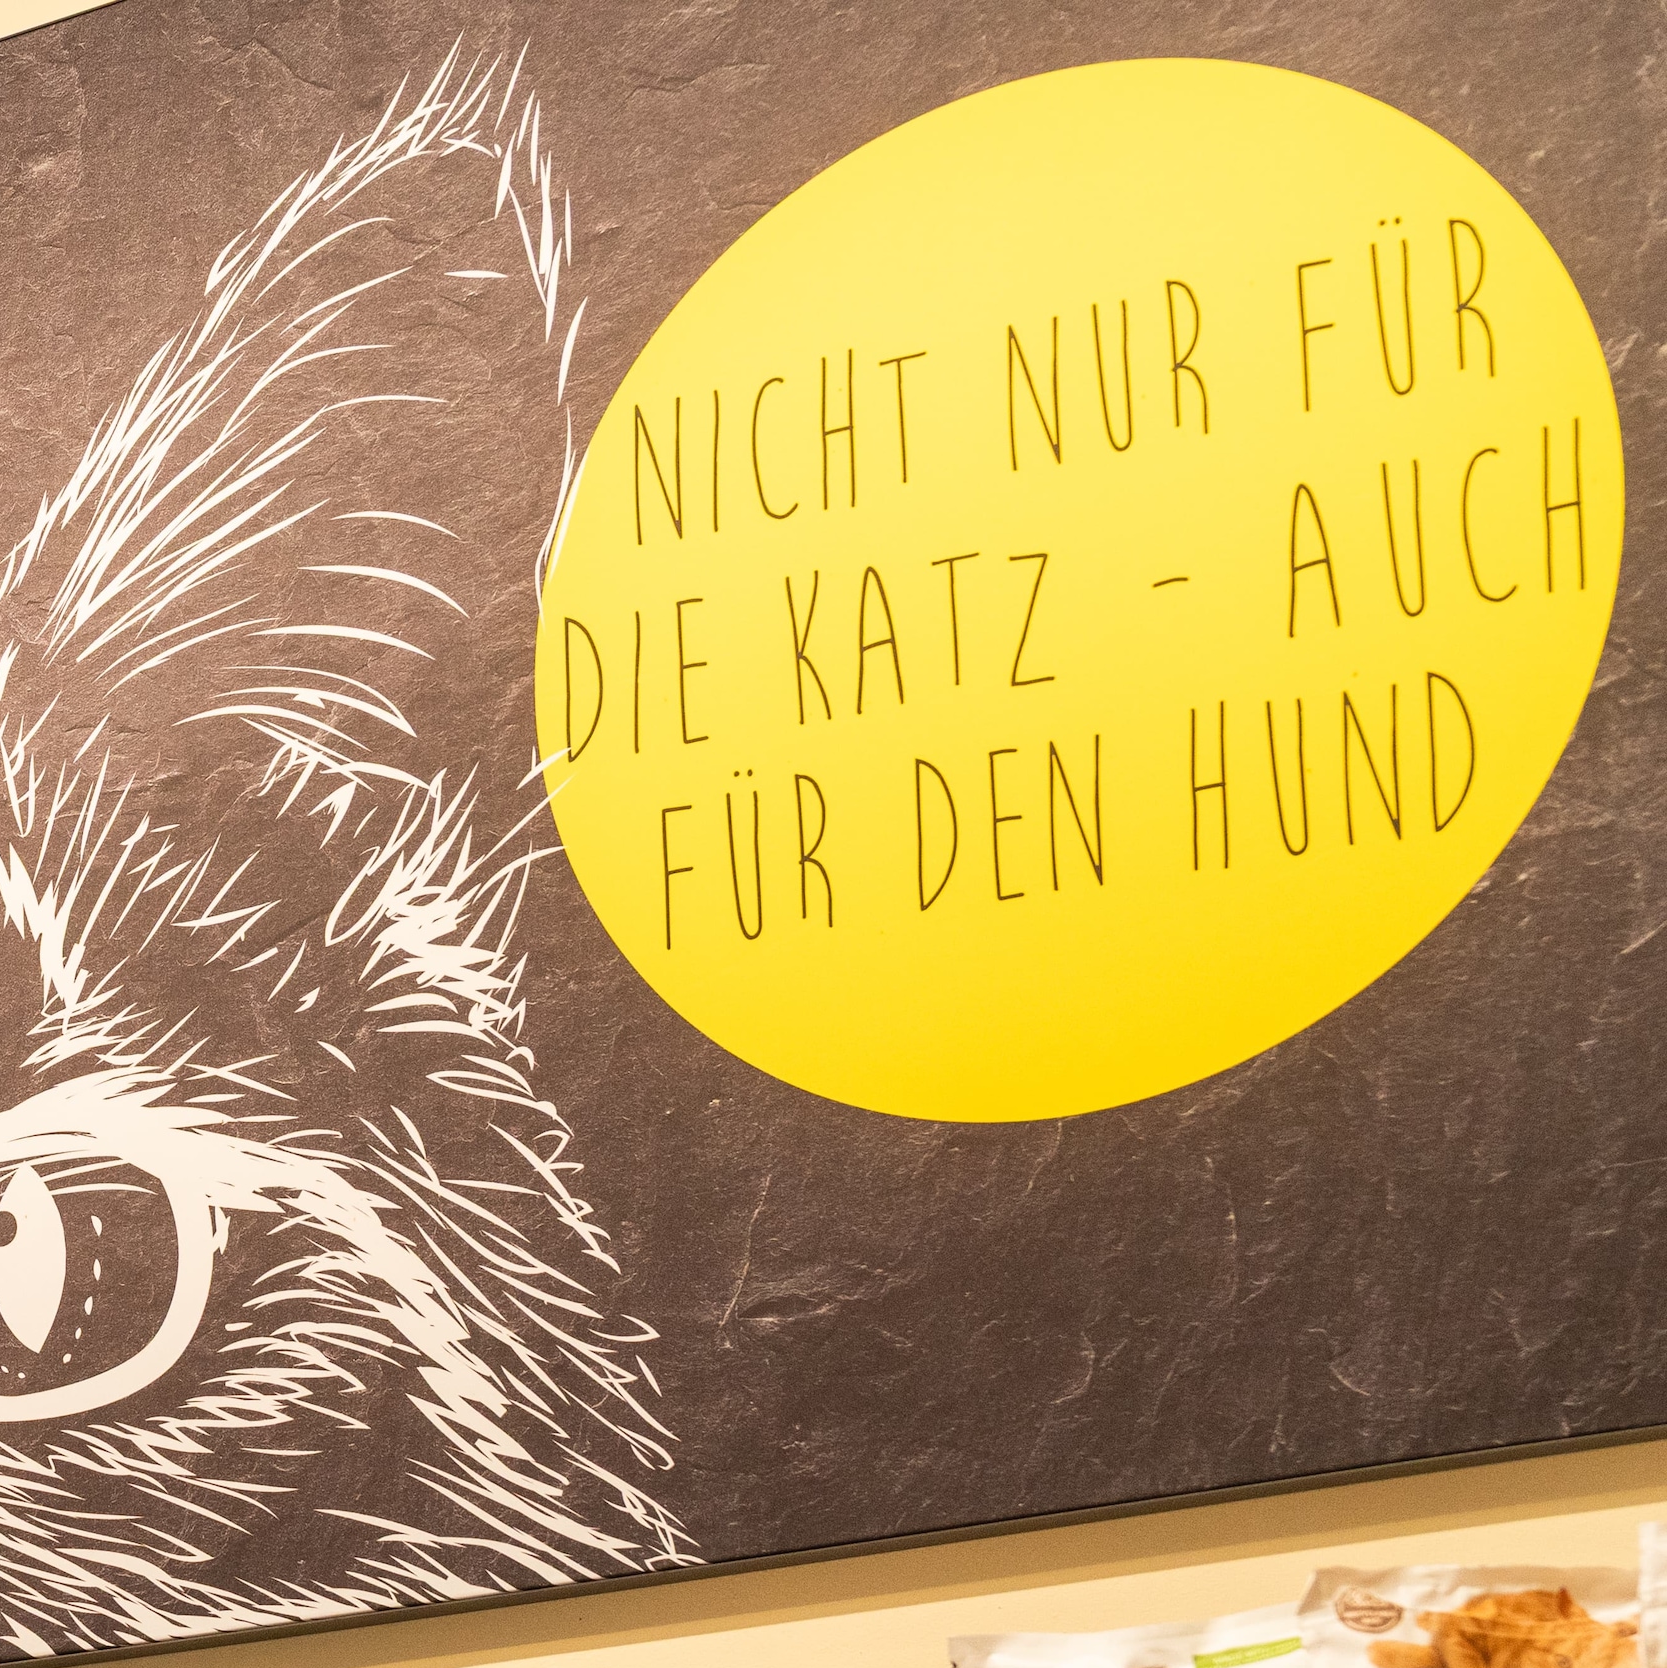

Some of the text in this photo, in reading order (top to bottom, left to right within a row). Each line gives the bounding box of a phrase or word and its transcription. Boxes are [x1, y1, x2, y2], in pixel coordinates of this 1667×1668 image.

[634, 217, 1495, 546] NICHT NUR FÜR
[563, 597, 710, 764] DIE
[785, 552, 1057, 726] KATZ
[1288, 416, 1587, 638] AUCH
[660, 671, 1477, 950] FÜR DEN HUND
